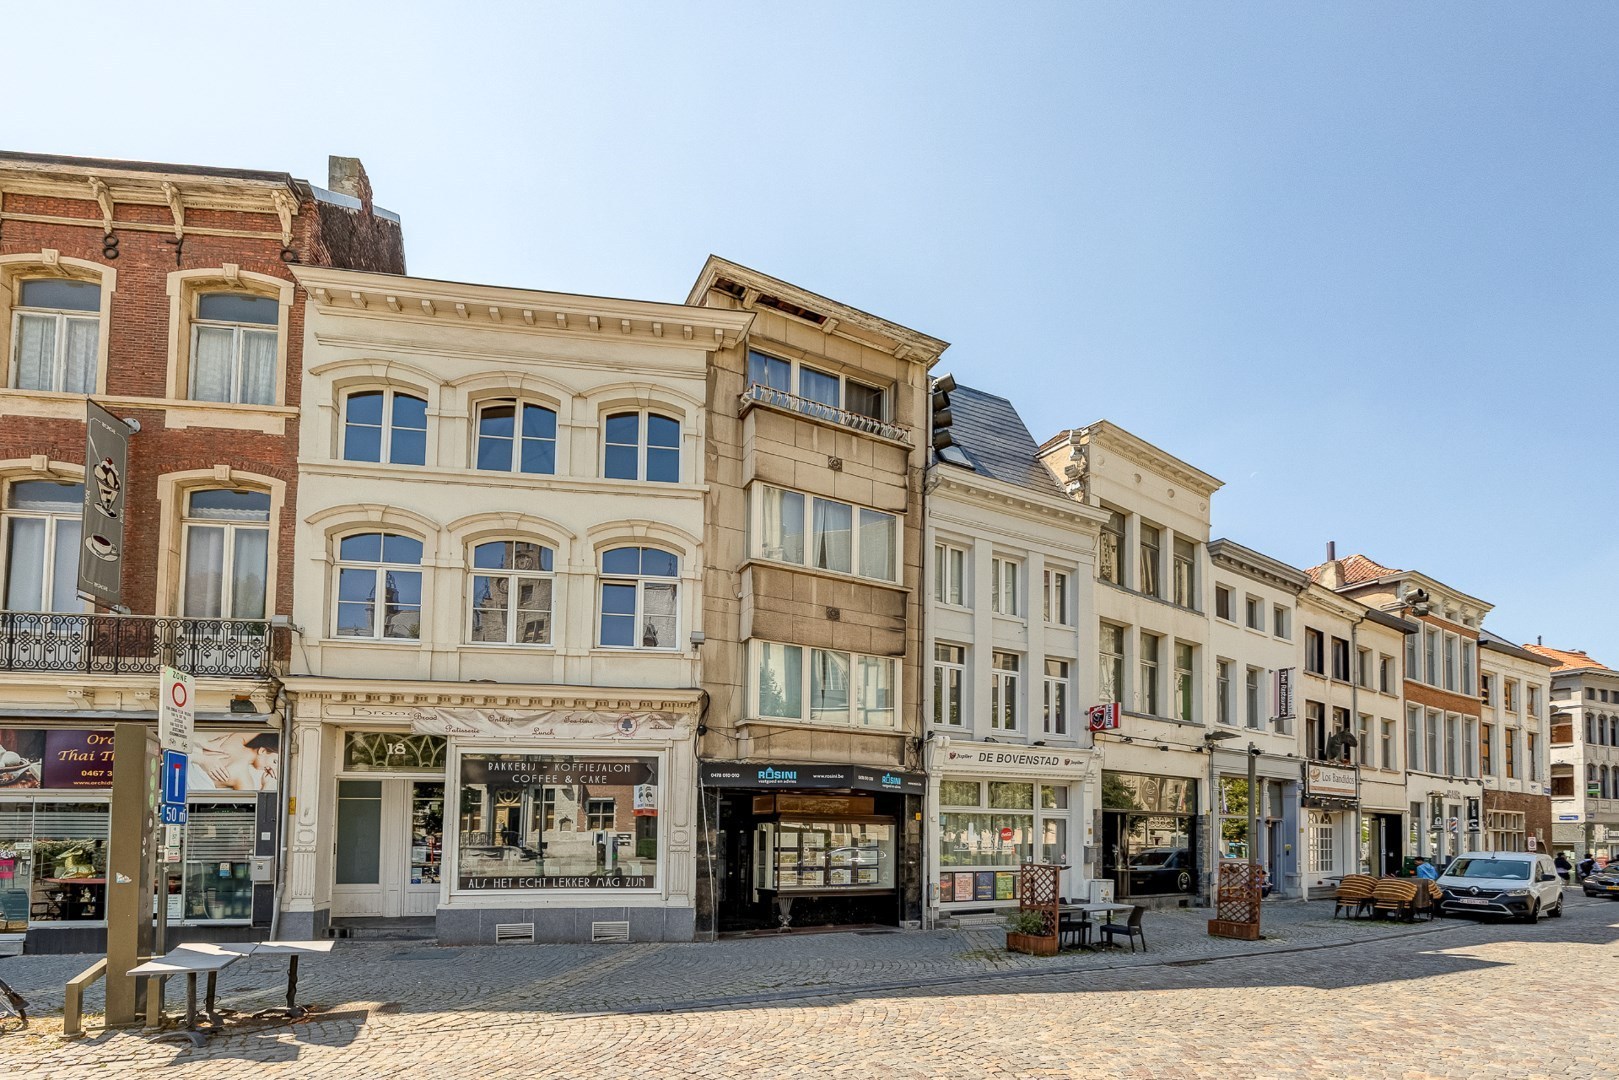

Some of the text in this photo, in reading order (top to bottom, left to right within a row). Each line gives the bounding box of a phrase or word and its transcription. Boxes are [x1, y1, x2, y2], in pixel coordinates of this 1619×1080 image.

[172, 670, 188, 683] ZONE
[414, 712, 438, 721] Brood
[488, 714, 514, 726] Ontbijt
[564, 716, 594, 724] Tea-time
[445, 724, 481, 734] Patisserie
[532, 727, 555, 736] Lunch
[387, 743, 407, 755] 18
[58, 749, 96, 762] Thai
[978, 752, 1060, 766] DE BOVENSTAD
[488, 762, 536, 772] BAKKERIJ
[555, 763, 631, 773] KOFFIESALON
[512, 774, 607, 784] COFFEE & CAKE
[758, 769, 797, 779] ROSINI
[1322, 772, 1355, 785] Los Bandidos
[166, 807, 177, 822] 50
[468, 877, 647, 889] ALS HET ECHT LEKKER MAG ZIJN
